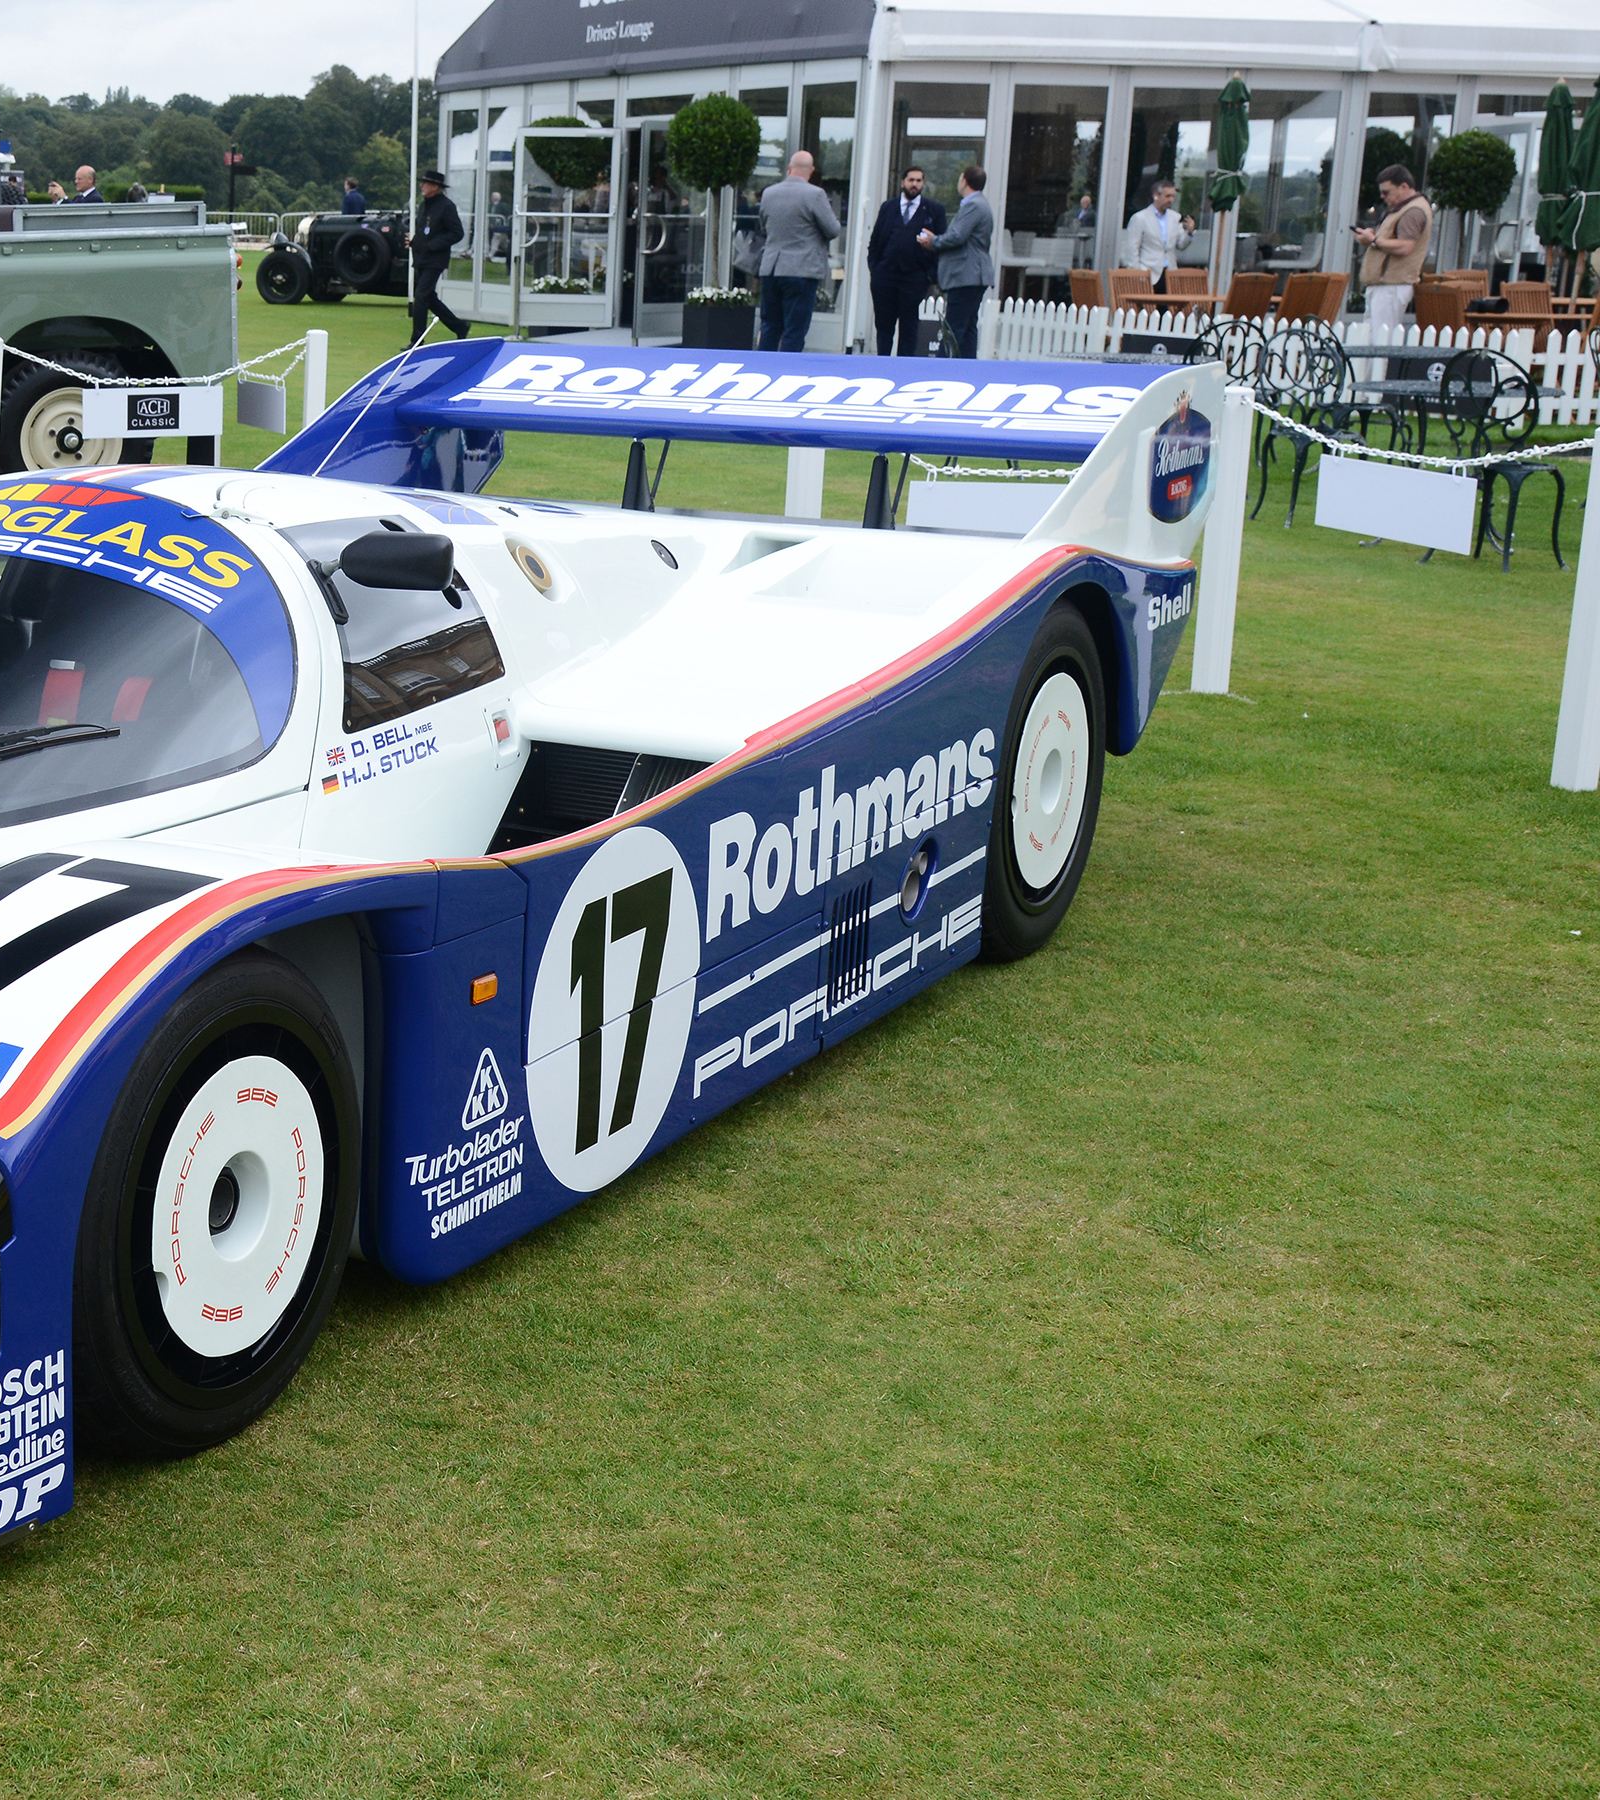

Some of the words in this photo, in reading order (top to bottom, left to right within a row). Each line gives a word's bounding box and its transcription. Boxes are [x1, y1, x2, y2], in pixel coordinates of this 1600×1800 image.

[586, 21, 619, 43] Drivers'
[618, 20, 654, 42] Lounge
[140, 400, 167, 414] ACH
[476, 355, 1142, 416] Rothmans
[131, 417, 176, 427] CLASSIC
[448, 391, 1117, 434] PORSCHE
[1155, 438, 1204, 477] Rothmans
[1170, 479, 1188, 495] RACING
[1147, 582, 1192, 631] Shell
[342, 761, 377, 788] H.J.
[380, 736, 439, 774] STUCK
[351, 740, 370, 758] D.
[372, 724, 413, 750] BELL
[414, 722, 433, 736] MBE
[705, 728, 995, 943] Rothmans
[569, 867, 674, 1156] 17
[236, 1087, 278, 1108] 962
[405, 1115, 525, 1186] Turbolader
[171, 1110, 215, 1287] PORSCHE
[421, 1143, 524, 1211] TELETRON
[264, 1127, 306, 1295] PORSCHE
[430, 1172, 522, 1239] SCHMITTHELM
[201, 1303, 244, 1322] 962
